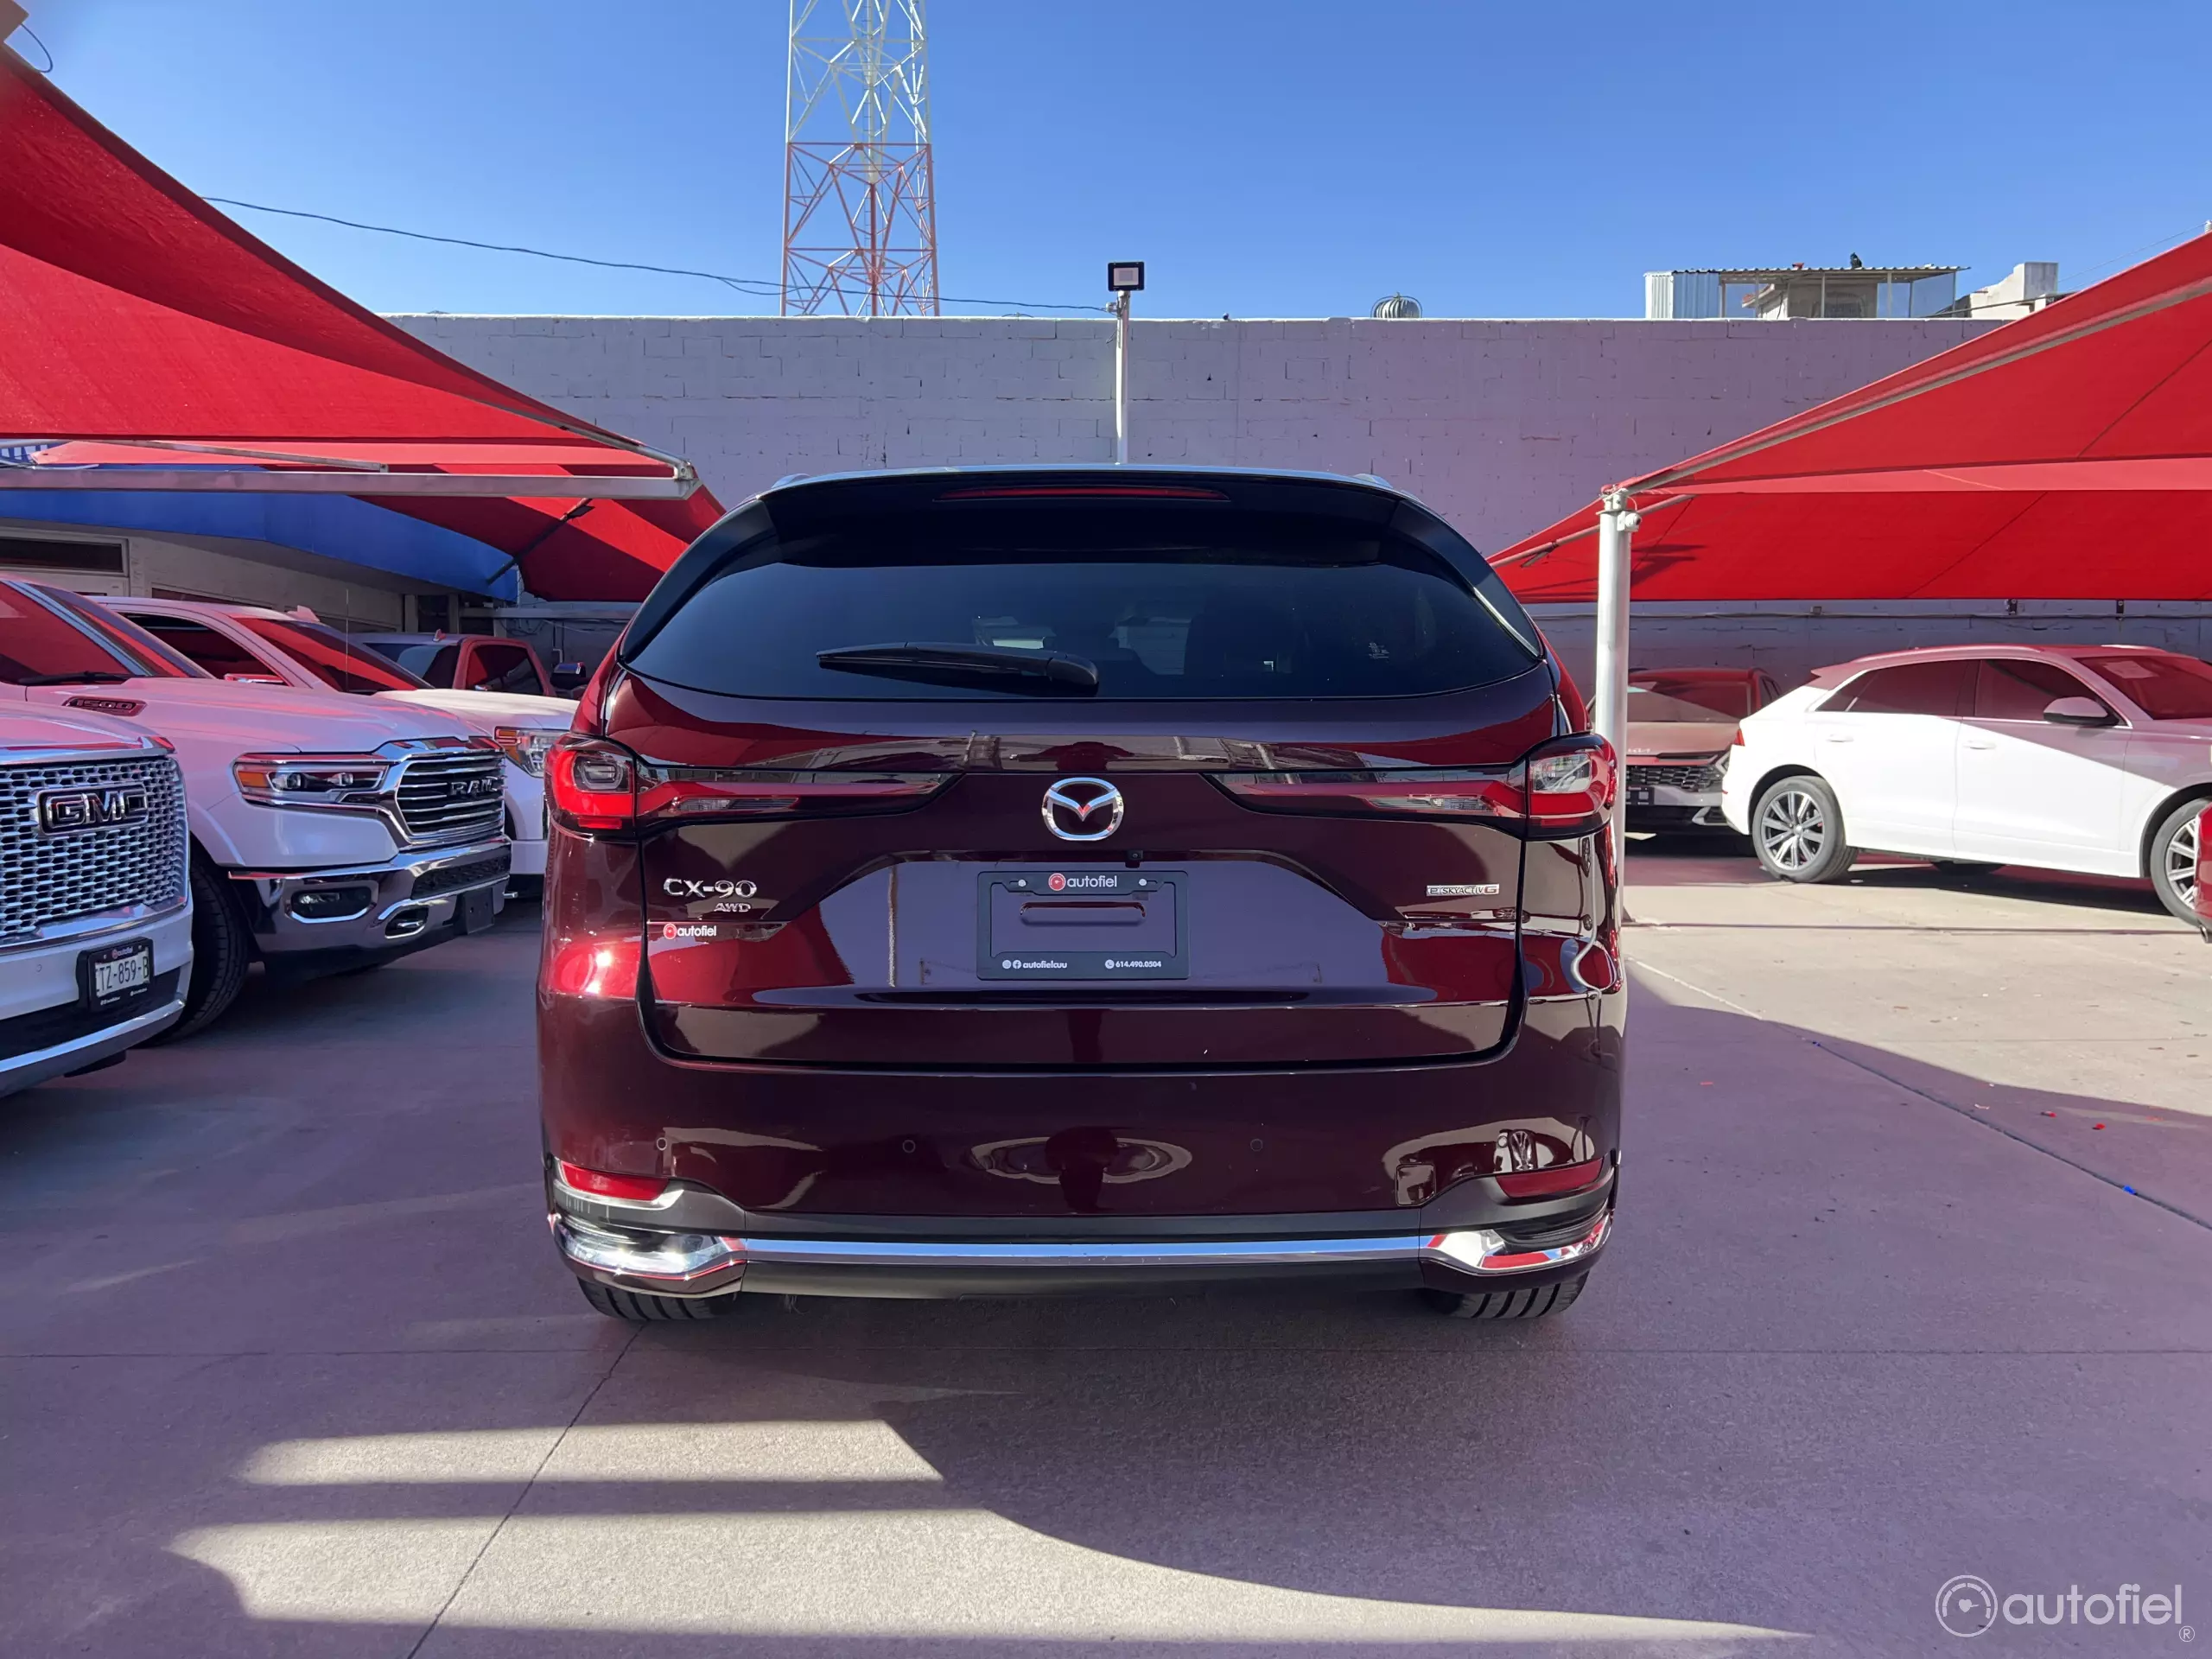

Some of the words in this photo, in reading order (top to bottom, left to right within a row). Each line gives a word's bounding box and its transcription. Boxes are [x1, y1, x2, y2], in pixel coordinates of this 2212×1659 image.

[451, 778, 495, 795] RAM
[46, 789, 149, 829] GMC
[1066, 875, 1117, 888] autofiel
[663, 877, 758, 899] CX-90
[714, 902, 752, 912] AWD
[677, 925, 717, 937] autofiel
[1022, 960, 1068, 969] autofielcuu
[1115, 960, 1162, 969] 614.490.0504
